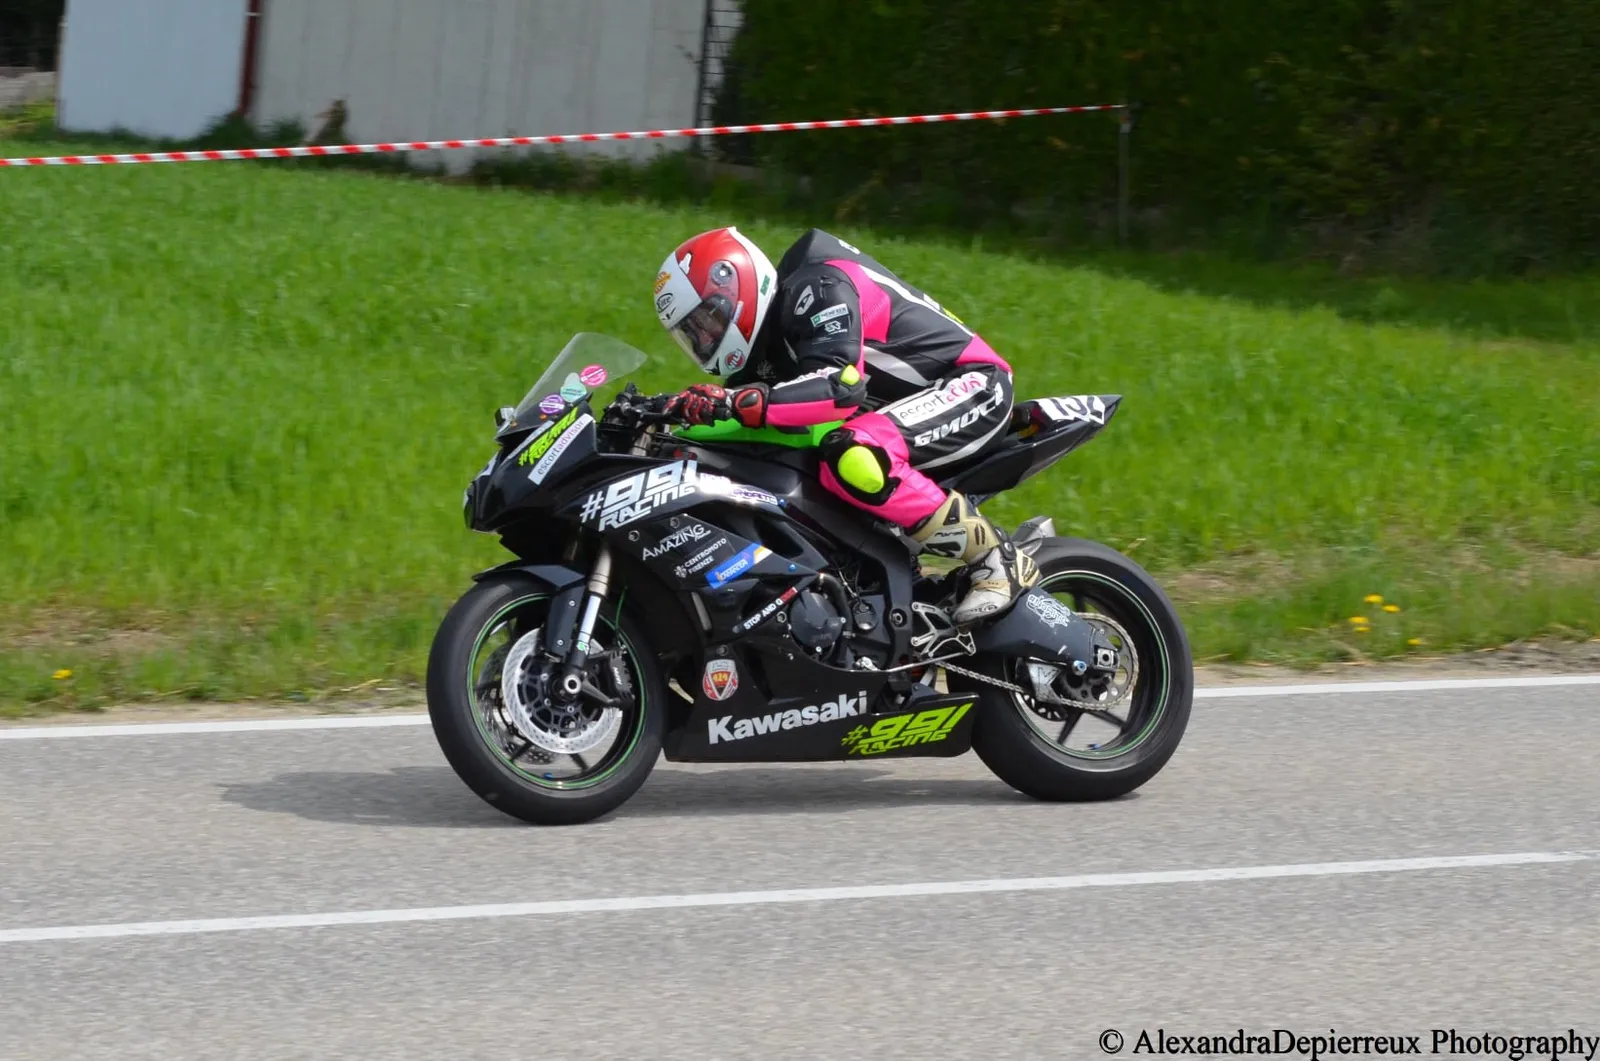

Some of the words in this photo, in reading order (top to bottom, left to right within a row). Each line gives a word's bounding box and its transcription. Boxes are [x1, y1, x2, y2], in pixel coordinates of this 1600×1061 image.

[537, 420, 585, 475] escortadvisor
[598, 483, 697, 532] RACING
[642, 524, 709, 561] AMAZING
[684, 537, 727, 568] CENTROMOTO
[687, 555, 715, 574] FIRENZE
[743, 613, 761, 630] STOP
[761, 603, 777, 617] AND
[707, 690, 868, 745] Kawasaki
[848, 728, 953, 756] RACING
